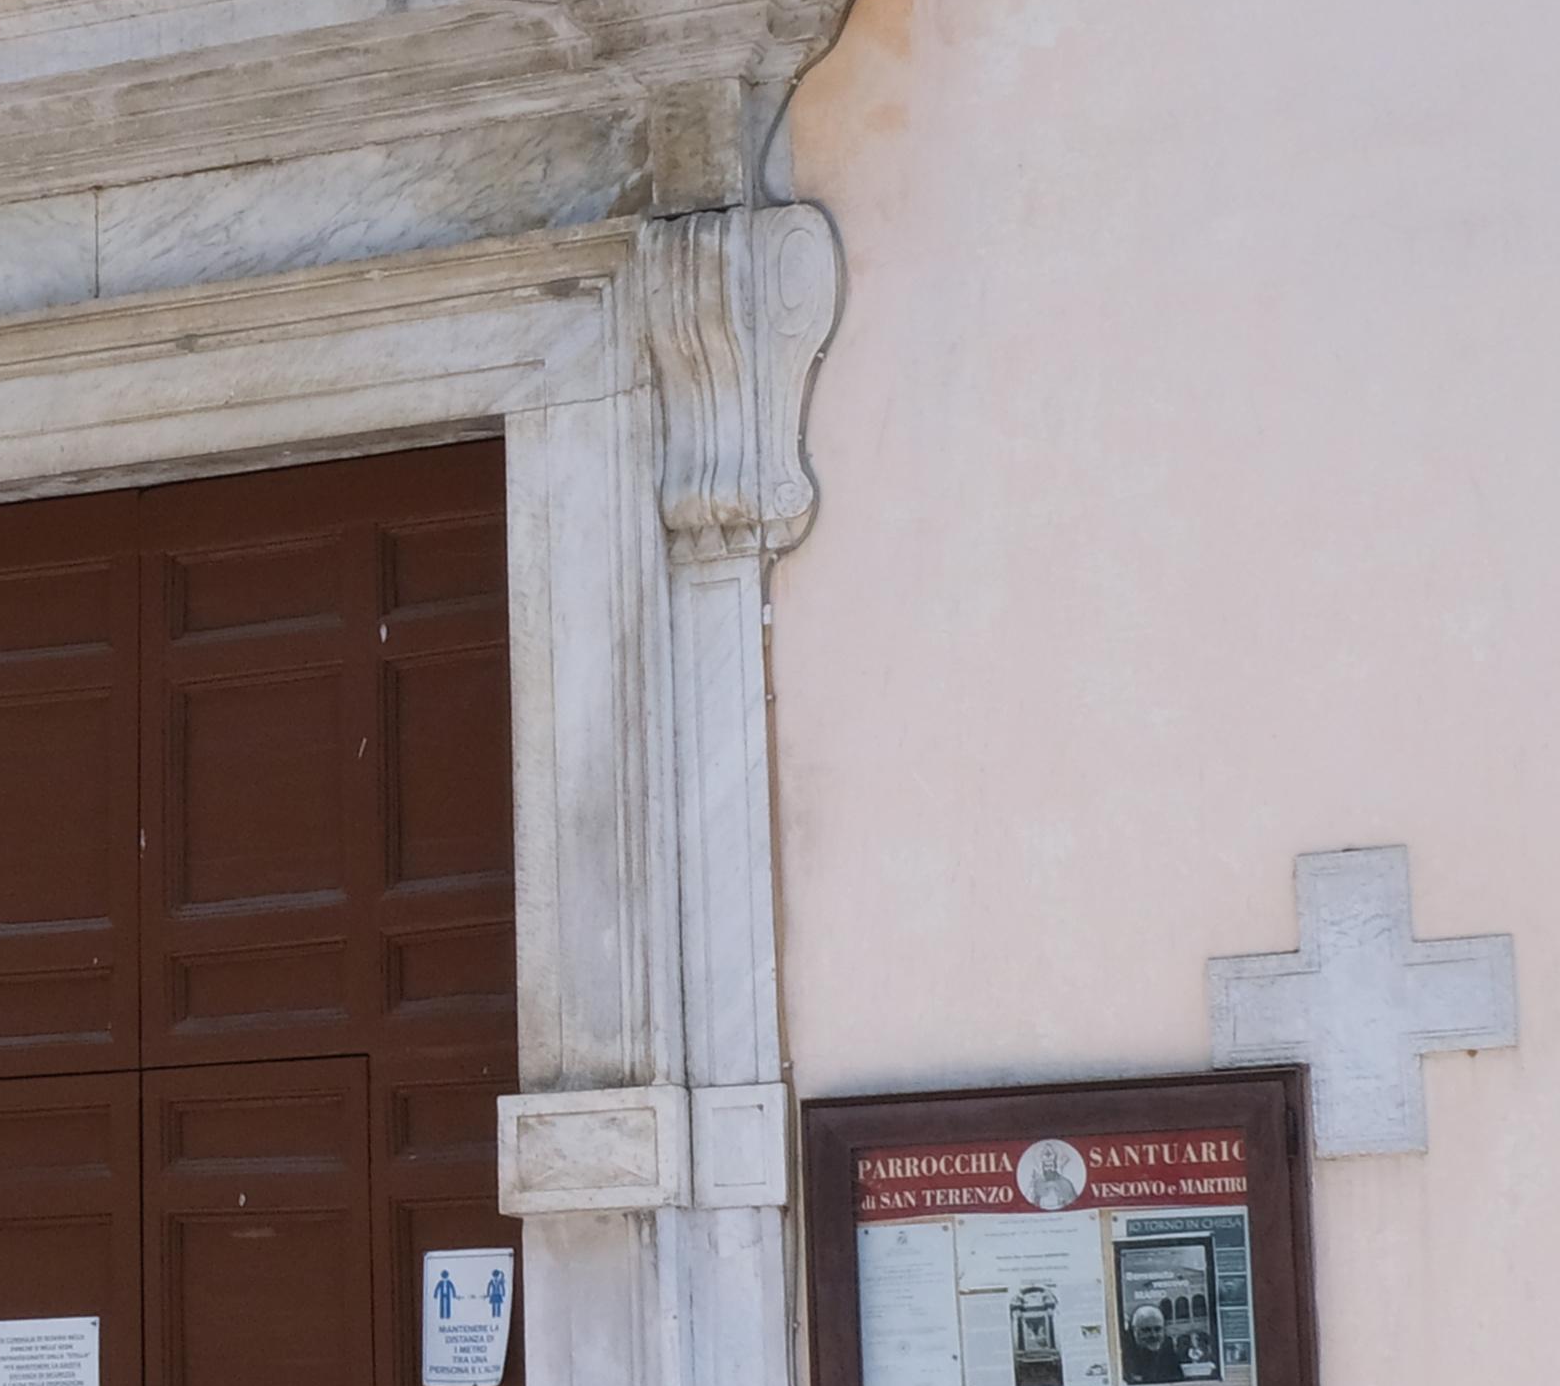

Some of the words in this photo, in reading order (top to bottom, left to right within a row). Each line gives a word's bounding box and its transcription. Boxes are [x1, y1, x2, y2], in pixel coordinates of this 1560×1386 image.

[858, 1151, 1014, 1181] PARROCCHIA
[860, 1194, 877, 1211] di
[880, 1190, 917, 1211] SAN
[921, 1184, 1014, 1208] TERENZO
[1090, 1179, 1166, 1199] VESCOVO
[1166, 1183, 1178, 1196] e
[1144, 1219, 1185, 1232] TORNO
[1186, 1219, 1199, 1229] IN
[438, 1324, 488, 1334] MANTENERE
[445, 1334, 485, 1344] DISTANZA
